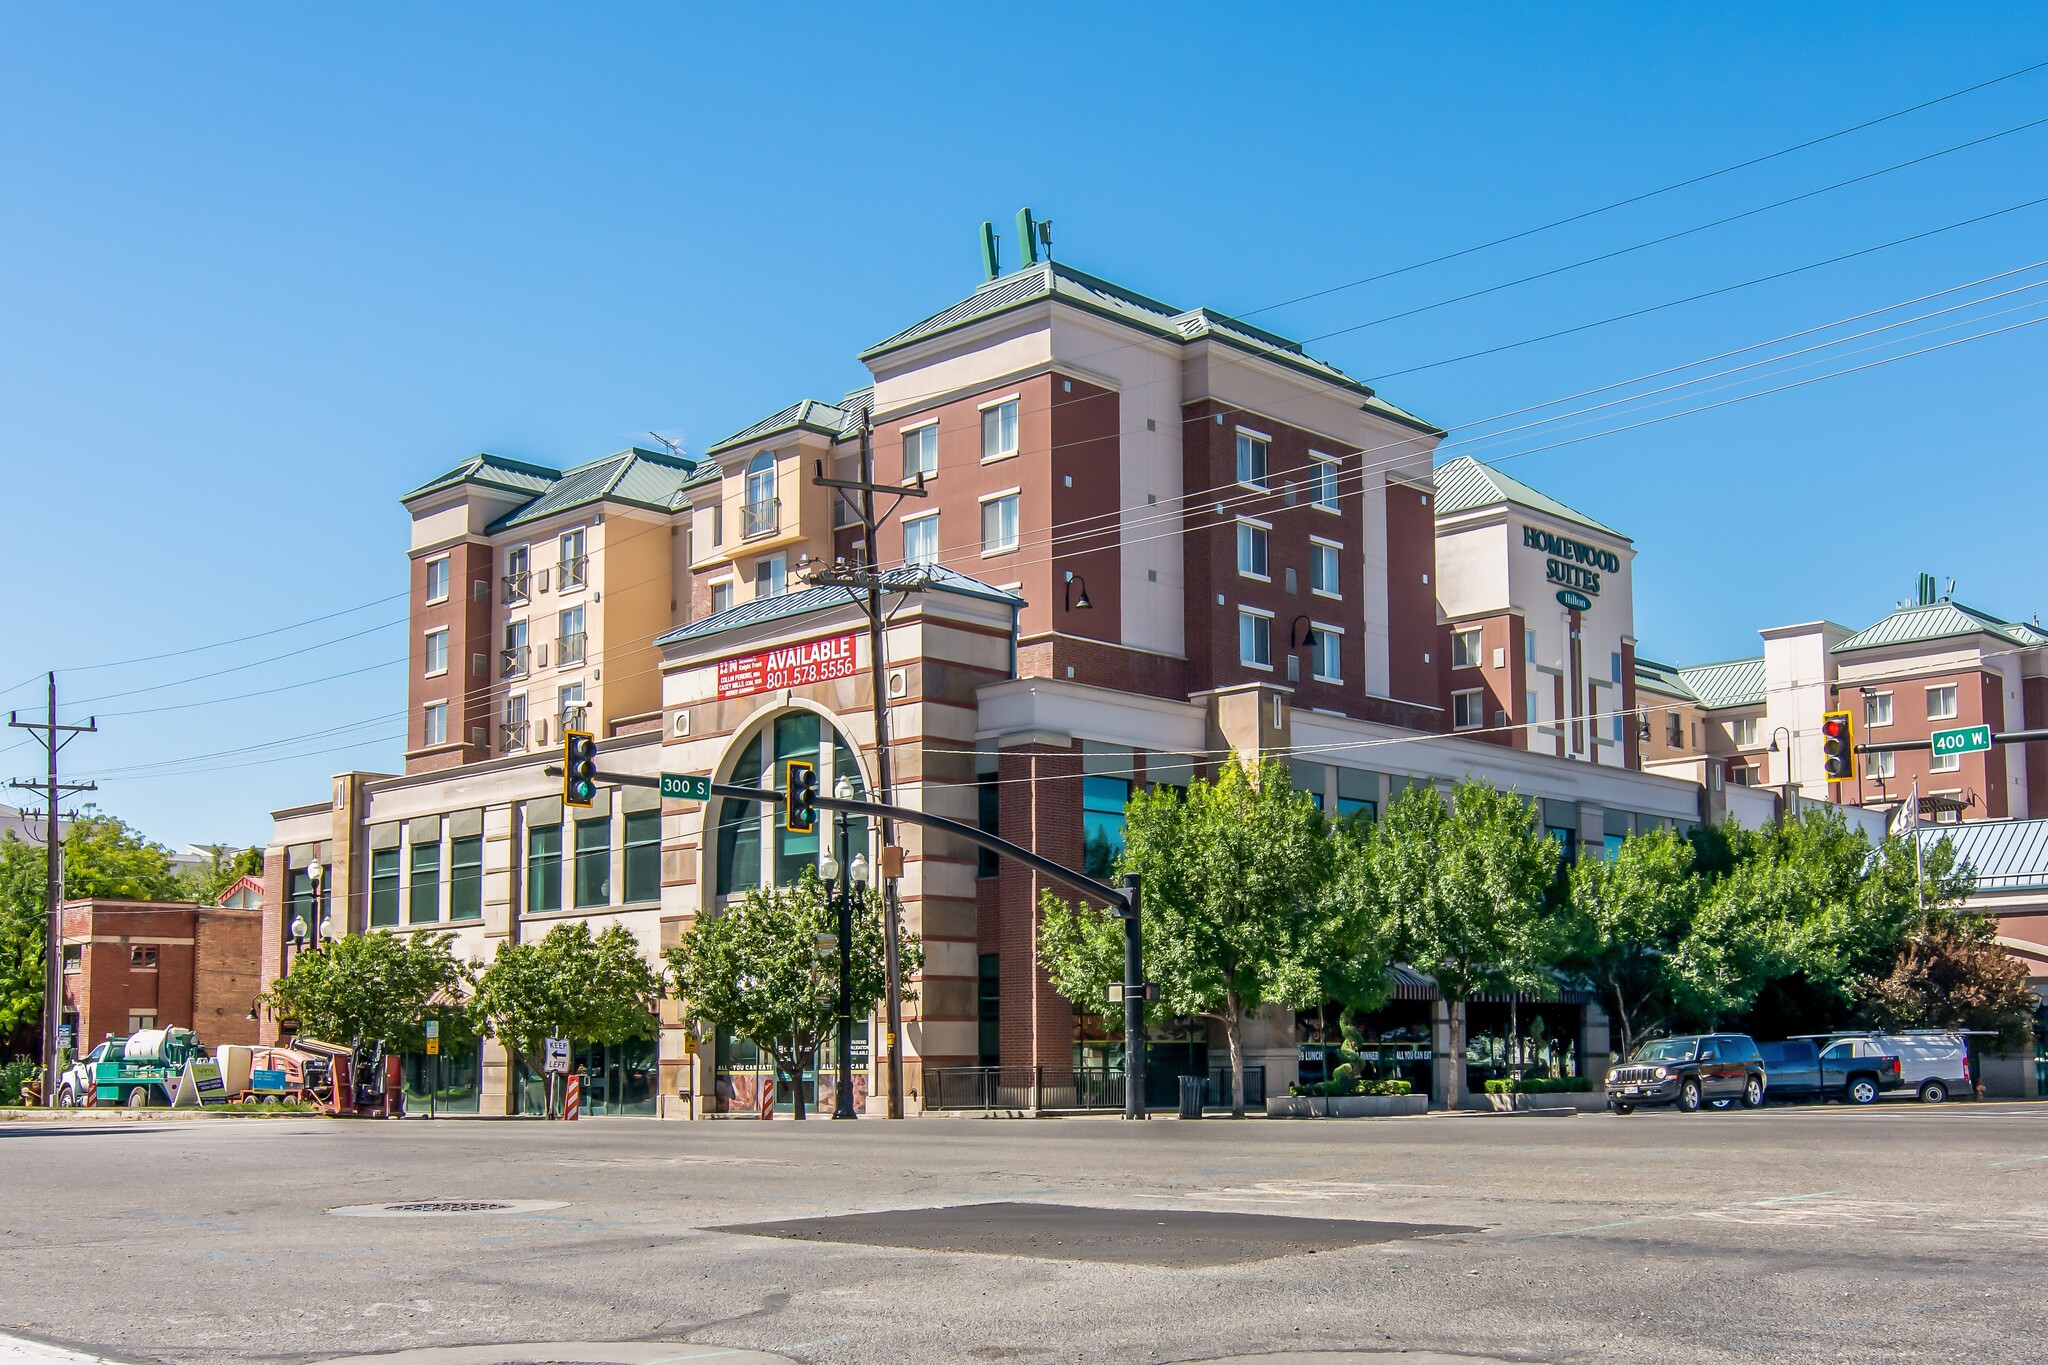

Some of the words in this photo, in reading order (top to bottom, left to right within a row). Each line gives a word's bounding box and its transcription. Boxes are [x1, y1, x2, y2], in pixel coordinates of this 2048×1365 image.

[1522, 524, 1620, 574] HOMEWOOD
[1546, 558, 1600, 593] SUITES
[1565, 593, 1586, 608] Hilton
[766, 637, 851, 671] AVAILABLE
[766, 657, 853, 689] 801.578.5556
[1937, 734, 1964, 750] 400
[1972, 732, 1986, 745] W.
[664, 778, 690, 793] 300
[697, 781, 708, 795] S.
[549, 1060, 565, 1068] LEFT
[1305, 1051, 1323, 1060] LUNCH
[1396, 1051, 1404, 1060] ALL
[1414, 1051, 1423, 1060] CAN
